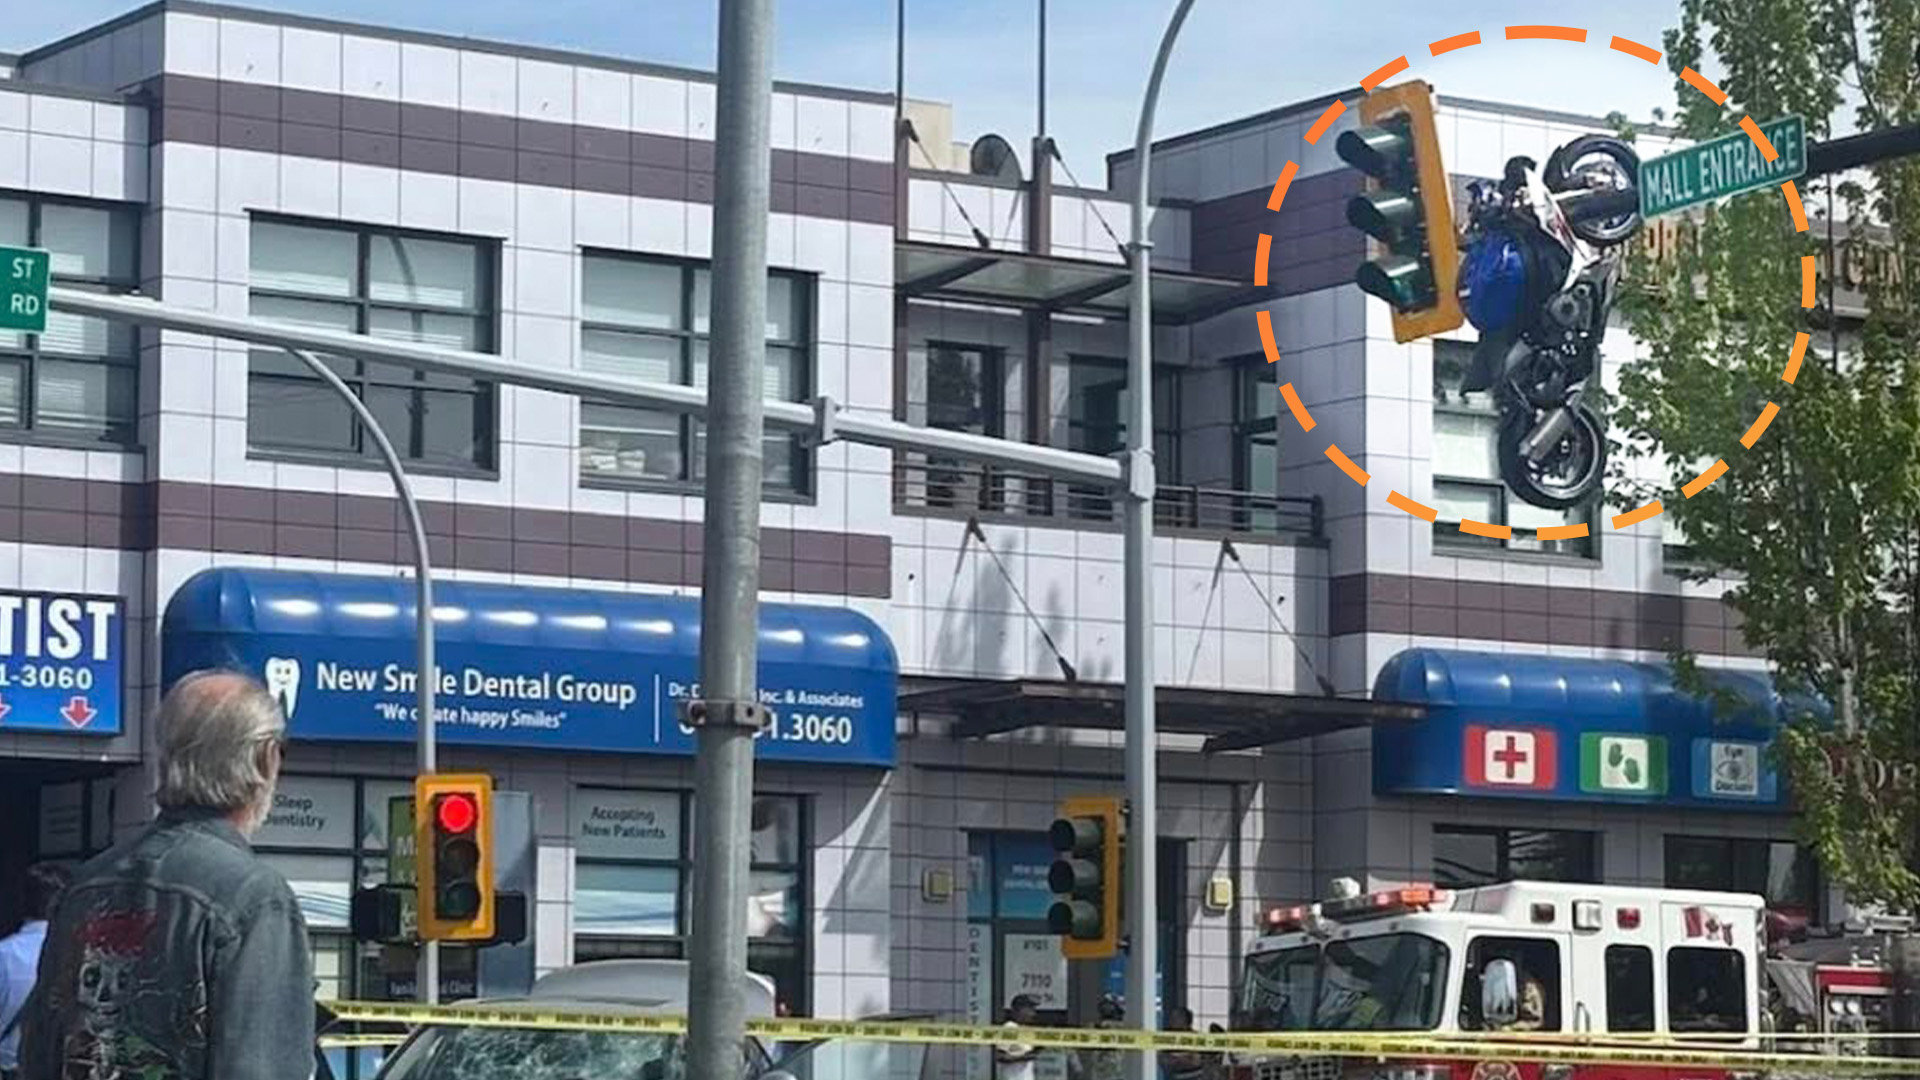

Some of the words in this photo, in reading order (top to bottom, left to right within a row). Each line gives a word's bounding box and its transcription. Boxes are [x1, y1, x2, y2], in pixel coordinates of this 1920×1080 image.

[1646, 155, 1694, 208] MALL
[12, 257, 34, 279] ST
[11, 293, 39, 315] RD
[317, 662, 376, 691] New
[384, 664, 456, 695] Smle
[465, 668, 550, 700] Dental
[556, 674, 636, 710] Group
[668, 682, 690, 698] Dr.
[799, 692, 864, 708] Associates
[410, 707, 458, 723] cate
[461, 706, 509, 729] happy
[274, 794, 313, 811] Sleep
[591, 805, 655, 825] Accepting
[582, 824, 609, 838] New
[613, 825, 666, 840] Patients
